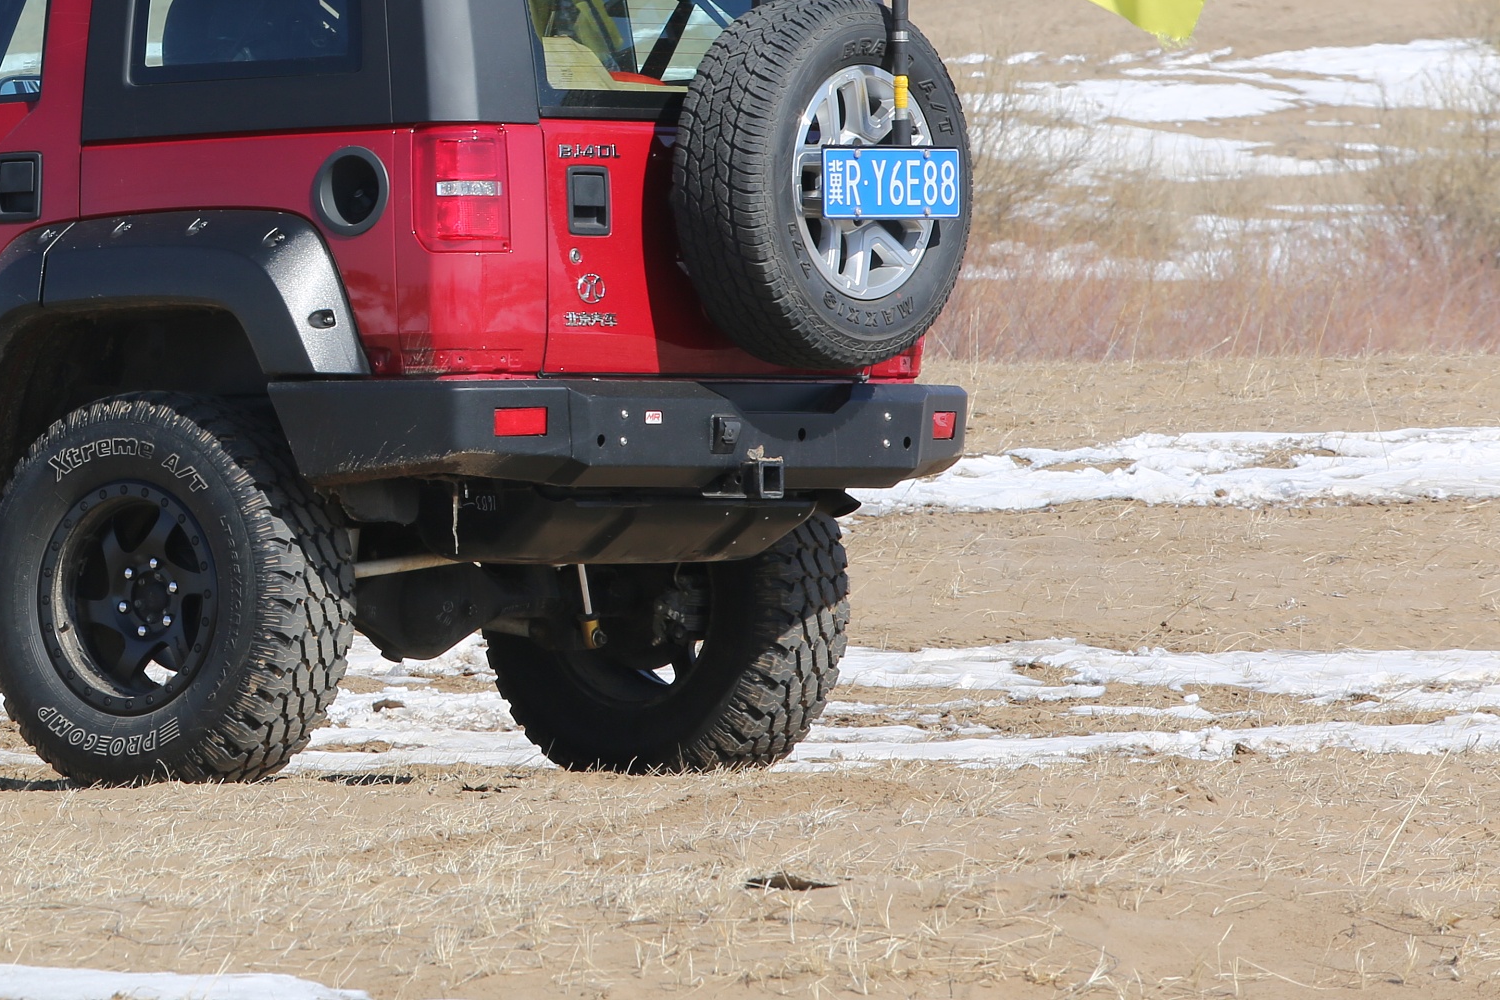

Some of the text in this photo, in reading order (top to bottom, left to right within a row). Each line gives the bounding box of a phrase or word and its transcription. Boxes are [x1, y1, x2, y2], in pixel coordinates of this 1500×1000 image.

[828, 158, 957, 207] 冀R·Y6E88
[563, 310, 619, 327] 北京汽车
[48, 437, 209, 493] Xtreme A/T
